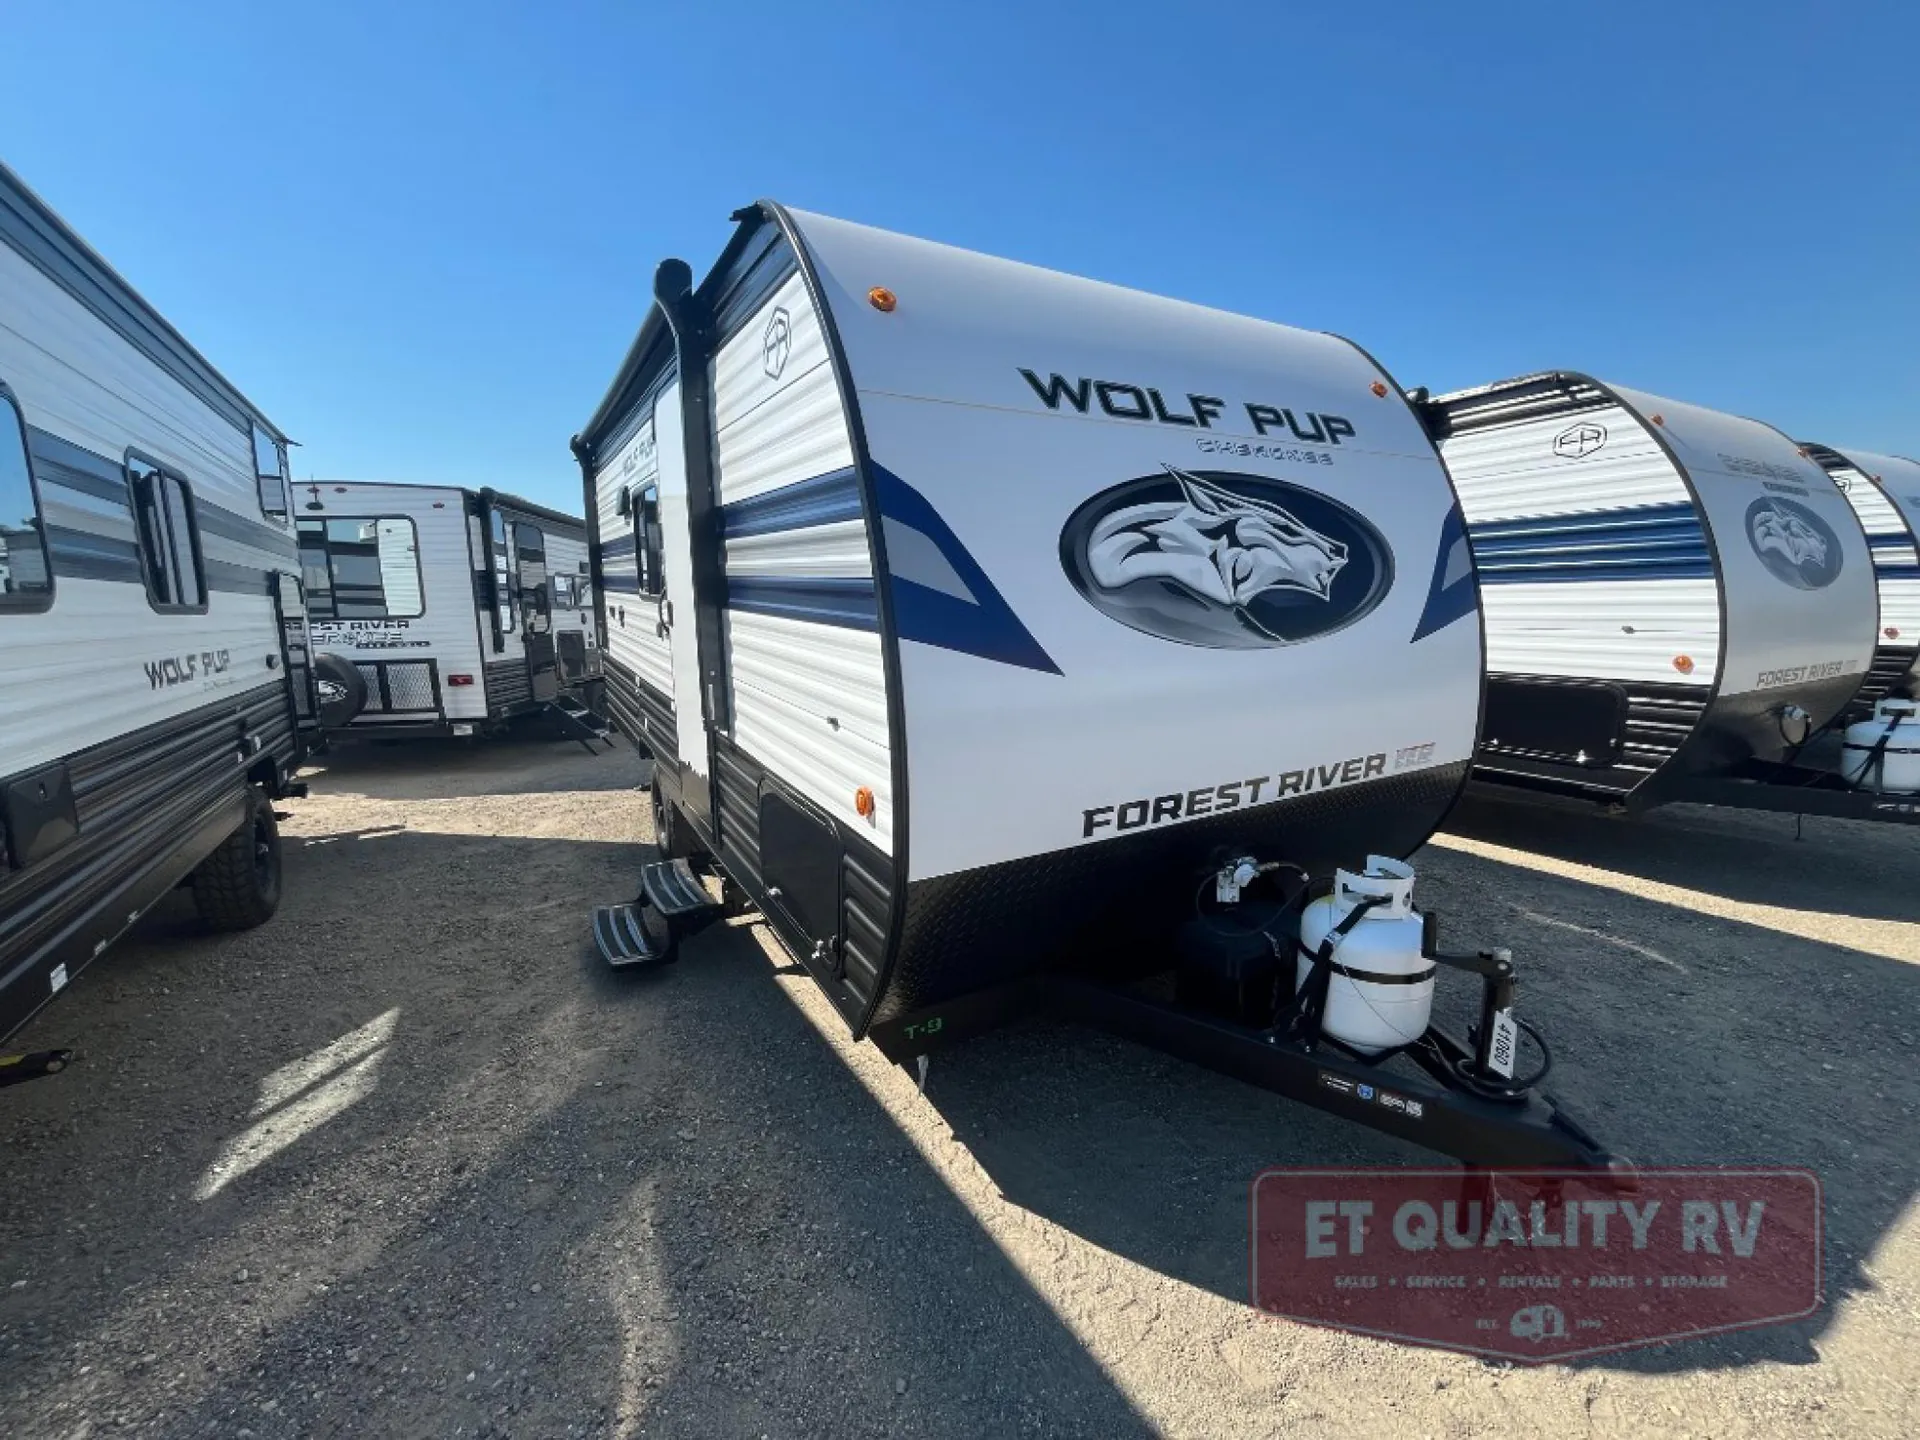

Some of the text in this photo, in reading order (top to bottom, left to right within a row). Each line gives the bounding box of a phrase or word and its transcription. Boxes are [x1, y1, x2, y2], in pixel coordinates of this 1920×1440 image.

[1016, 366, 1356, 445] WOLF PUP
[143, 654, 197, 690] WOLF
[201, 649, 230, 677] PUP
[1757, 666, 1808, 687] FOREST
[1809, 661, 1843, 679] RIVER
[1082, 775, 1270, 839] FOREST
[1278, 752, 1387, 798] RIVER
